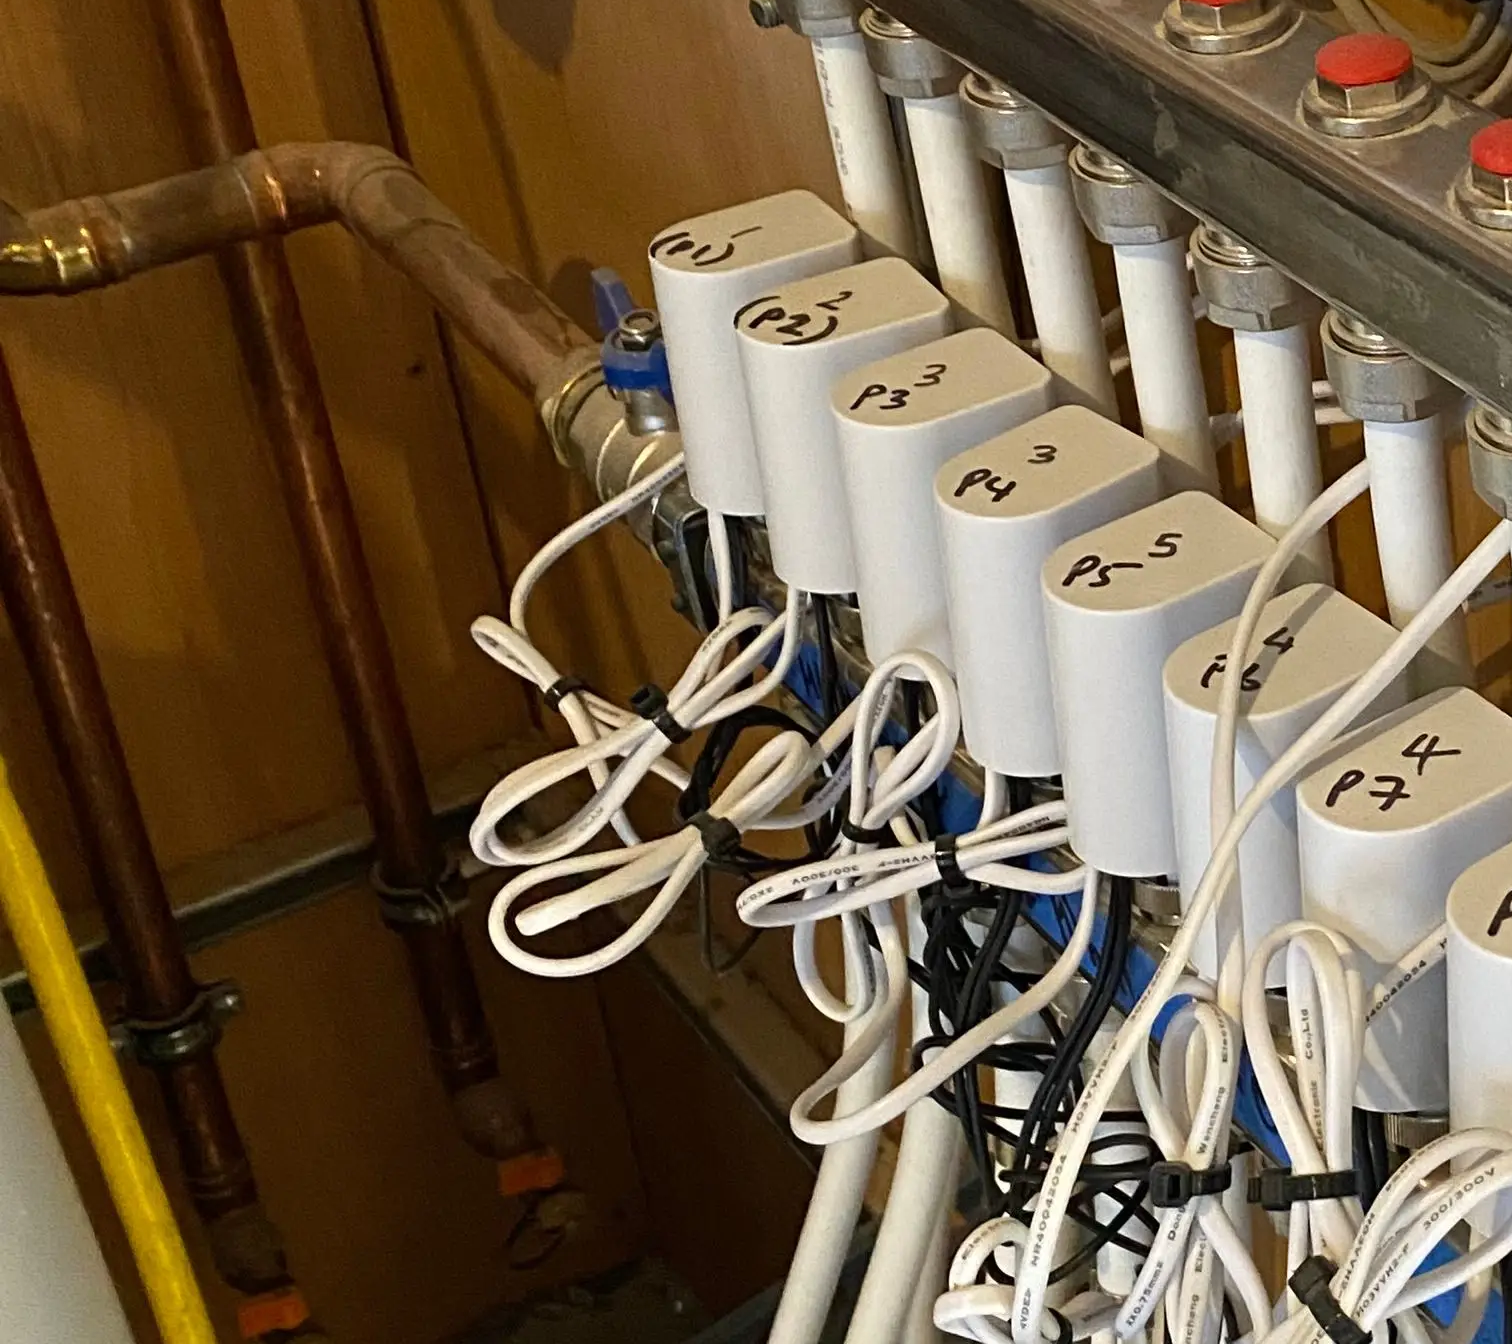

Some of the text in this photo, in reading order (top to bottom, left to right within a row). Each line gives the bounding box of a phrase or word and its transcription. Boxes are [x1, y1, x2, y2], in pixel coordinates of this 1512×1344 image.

[914, 362, 947, 388] 3
[849, 382, 910, 412] P3
[1028, 443, 1057, 466] 3
[953, 466, 1016, 503] P4
[1148, 532, 1183, 560] 5
[1263, 625, 1296, 656] 4
[1401, 733, 1461, 775] 4
[1324, 768, 1411, 812] P7
[1422, 1165, 1497, 1232] 300/300V
